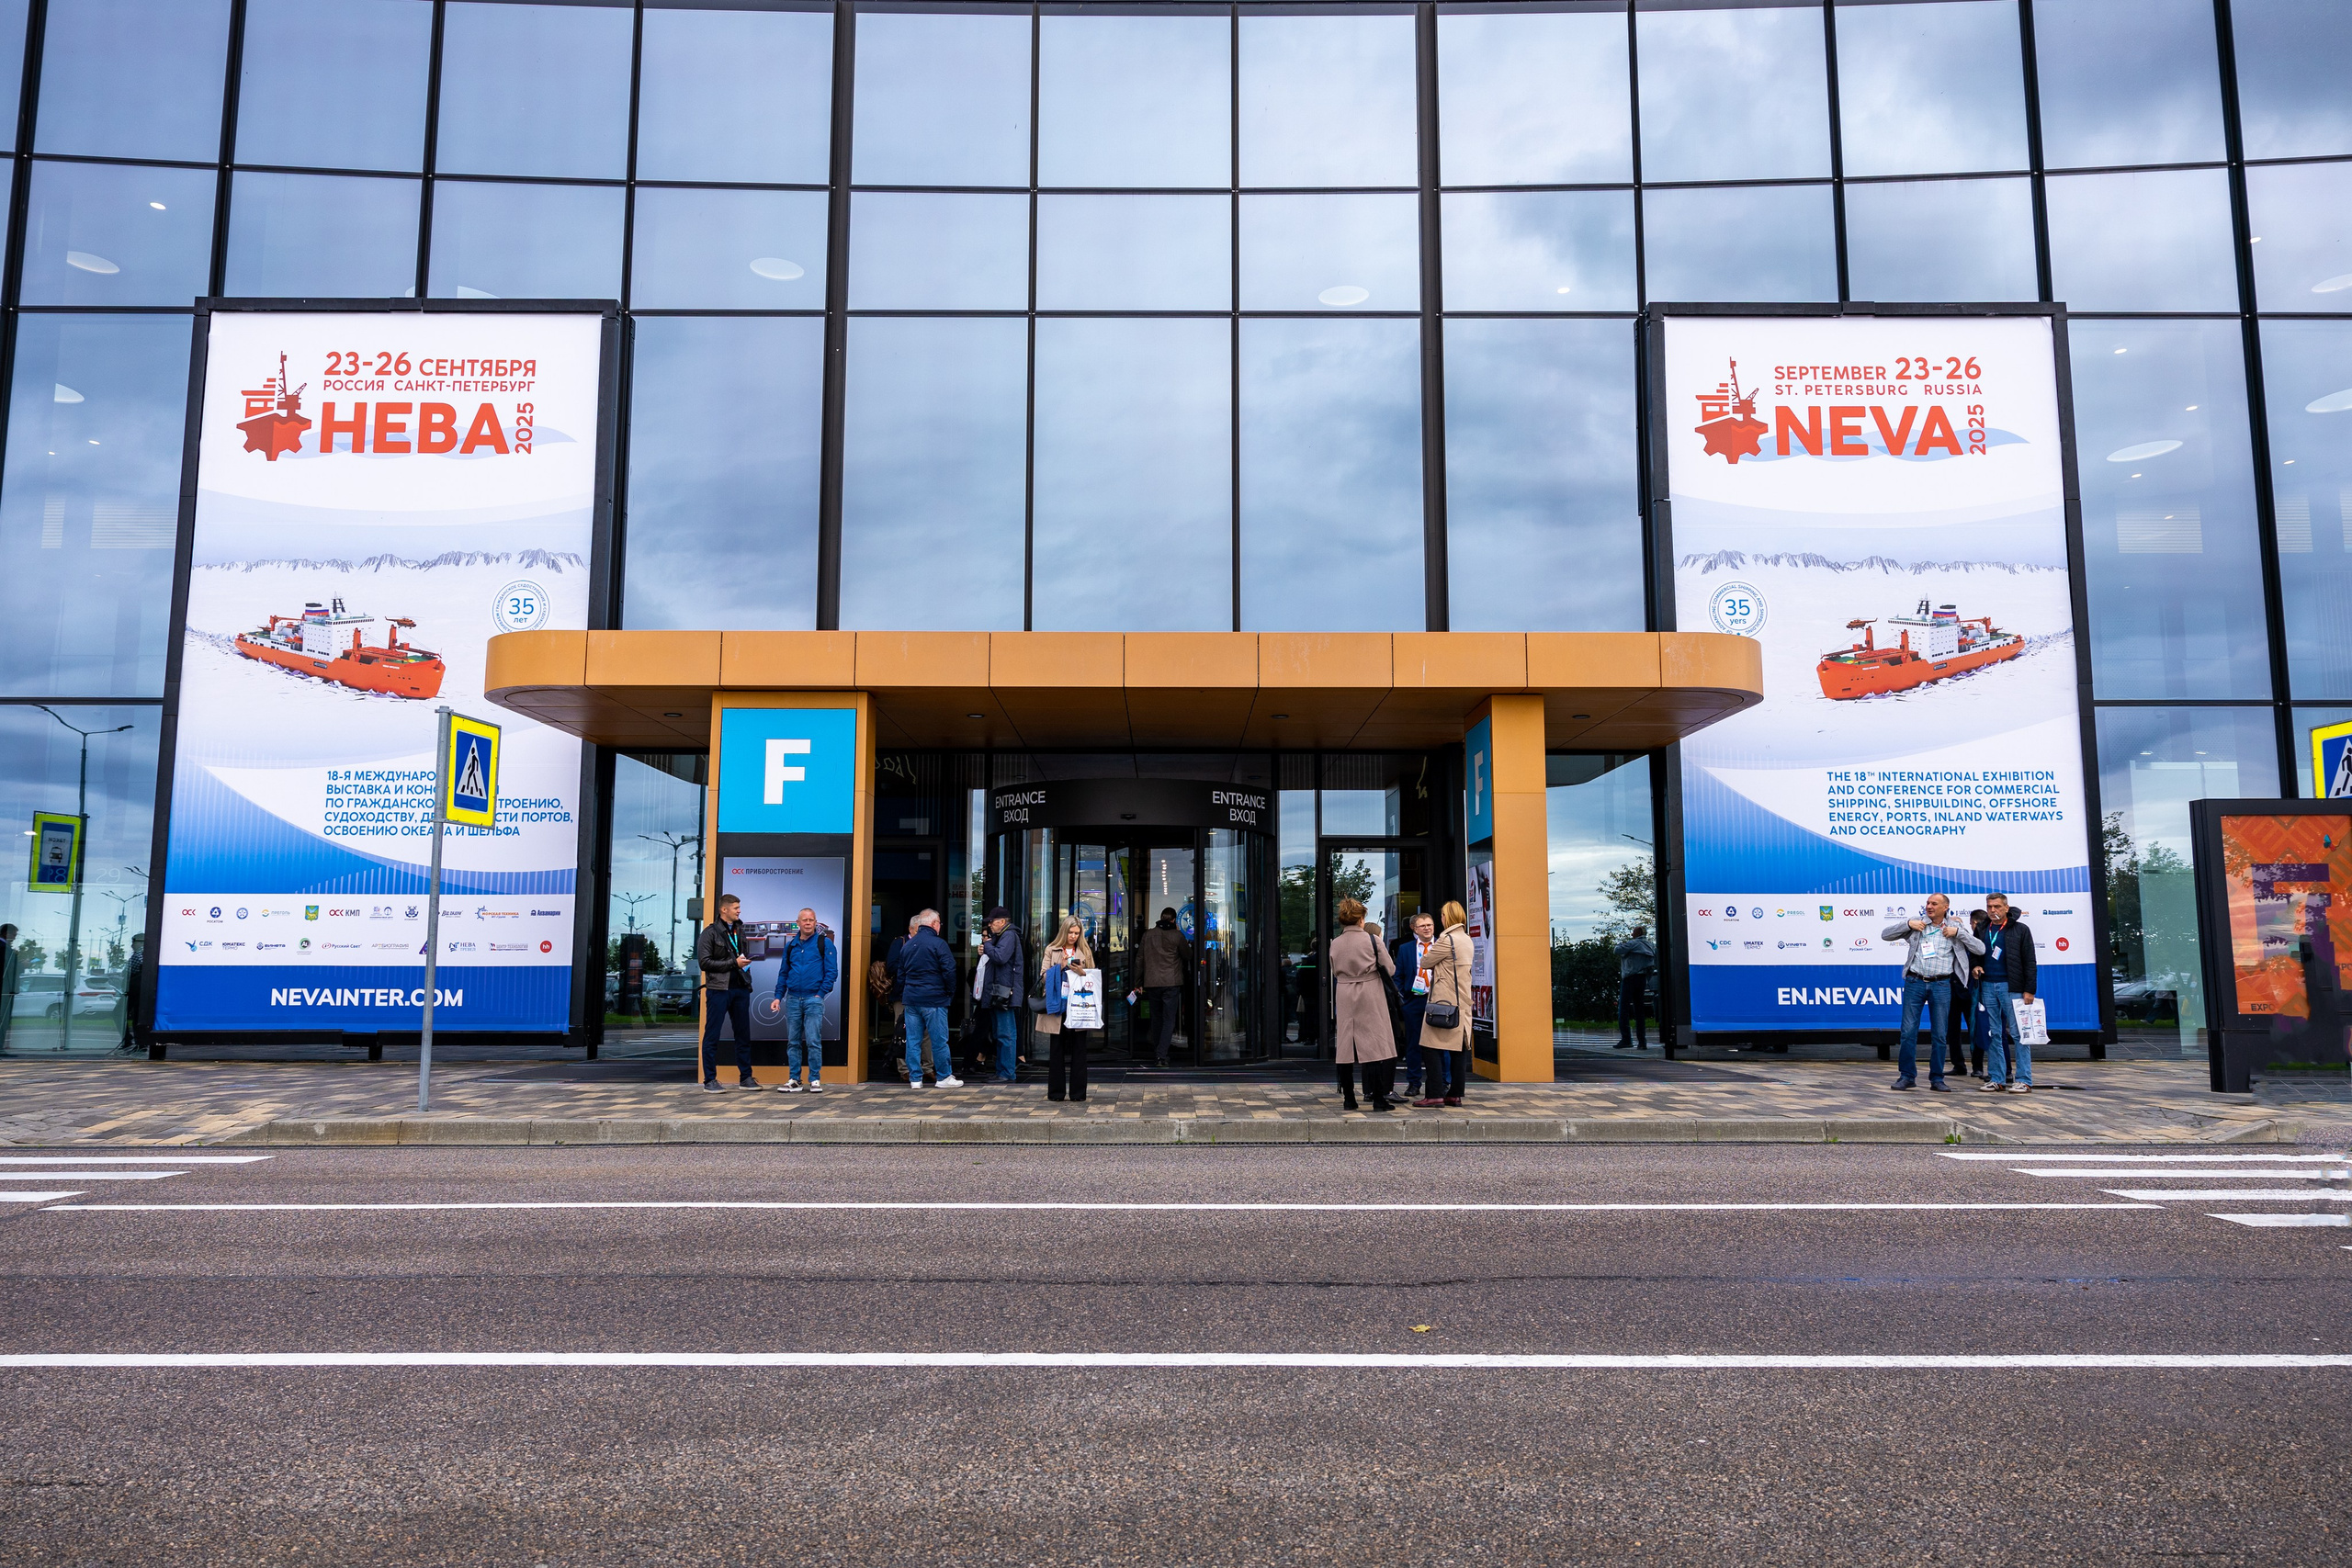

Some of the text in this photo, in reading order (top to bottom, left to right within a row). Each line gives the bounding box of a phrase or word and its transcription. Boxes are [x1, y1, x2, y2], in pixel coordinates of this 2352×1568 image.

[324, 352, 537, 378] 23-26 СЕНТЯБРЯ
[1774, 356, 1982, 380] SEPTEMBER 23-26
[323, 379, 536, 392] РОССИЯ САНКТ-ПЕТЕРБУРГ
[1775, 383, 1983, 396] ST. PETERSBURG RUSSIA
[320, 401, 511, 455] НЕВА
[514, 402, 534, 455] 2025
[1775, 405, 1964, 457] NEVA
[1967, 404, 1986, 456] 2025
[509, 598, 534, 615] 35
[1725, 599, 1750, 615] 35
[327, 771, 436, 782] 18-Я МЕЖДУНАРО
[763, 739, 811, 805] F
[1826, 772, 1851, 782] THE
[1878, 772, 1980, 782] INTERNATIONAL
[1983, 771, 2054, 781] EXHIBITION
[326, 784, 392, 795] ВЫСТАВКА
[394, 784, 403, 795] И
[1474, 750, 1484, 816] F
[1827, 784, 2061, 795] AND CONFERENCE FOR COMMERCIAL
[325, 798, 563, 810] ПО ГРАЖДАНСКО ТРОЕНИЮ,
[995, 791, 1046, 809] ENTRANCE
[1212, 791, 1266, 810] ENTRANCE
[1828, 798, 2057, 810] SHIPPING, SHIPBUILDING, OFFSHORE
[324, 812, 418, 824] СУДОХОДСТВУ,
[521, 812, 573, 824] ПОРТОВ,
[1003, 808, 1029, 824] ВХОД
[1229, 808, 1256, 826] ВХОД
[1828, 811, 2064, 824] ENERGY, PORTS, INLAND WATERWAYS
[323, 826, 398, 836] ОСВОЕНИЮ
[401, 826, 452, 836] ОКЕАА
[456, 826, 465, 836] И
[1829, 826, 1966, 836] AND OCEANOGRAPHY
[96, 868, 120, 883] 29
[345, 908, 360, 917] КМП
[270, 987, 463, 1007] NEVAINTER.COM
[1777, 987, 1905, 1006] EN.NEVAIN
